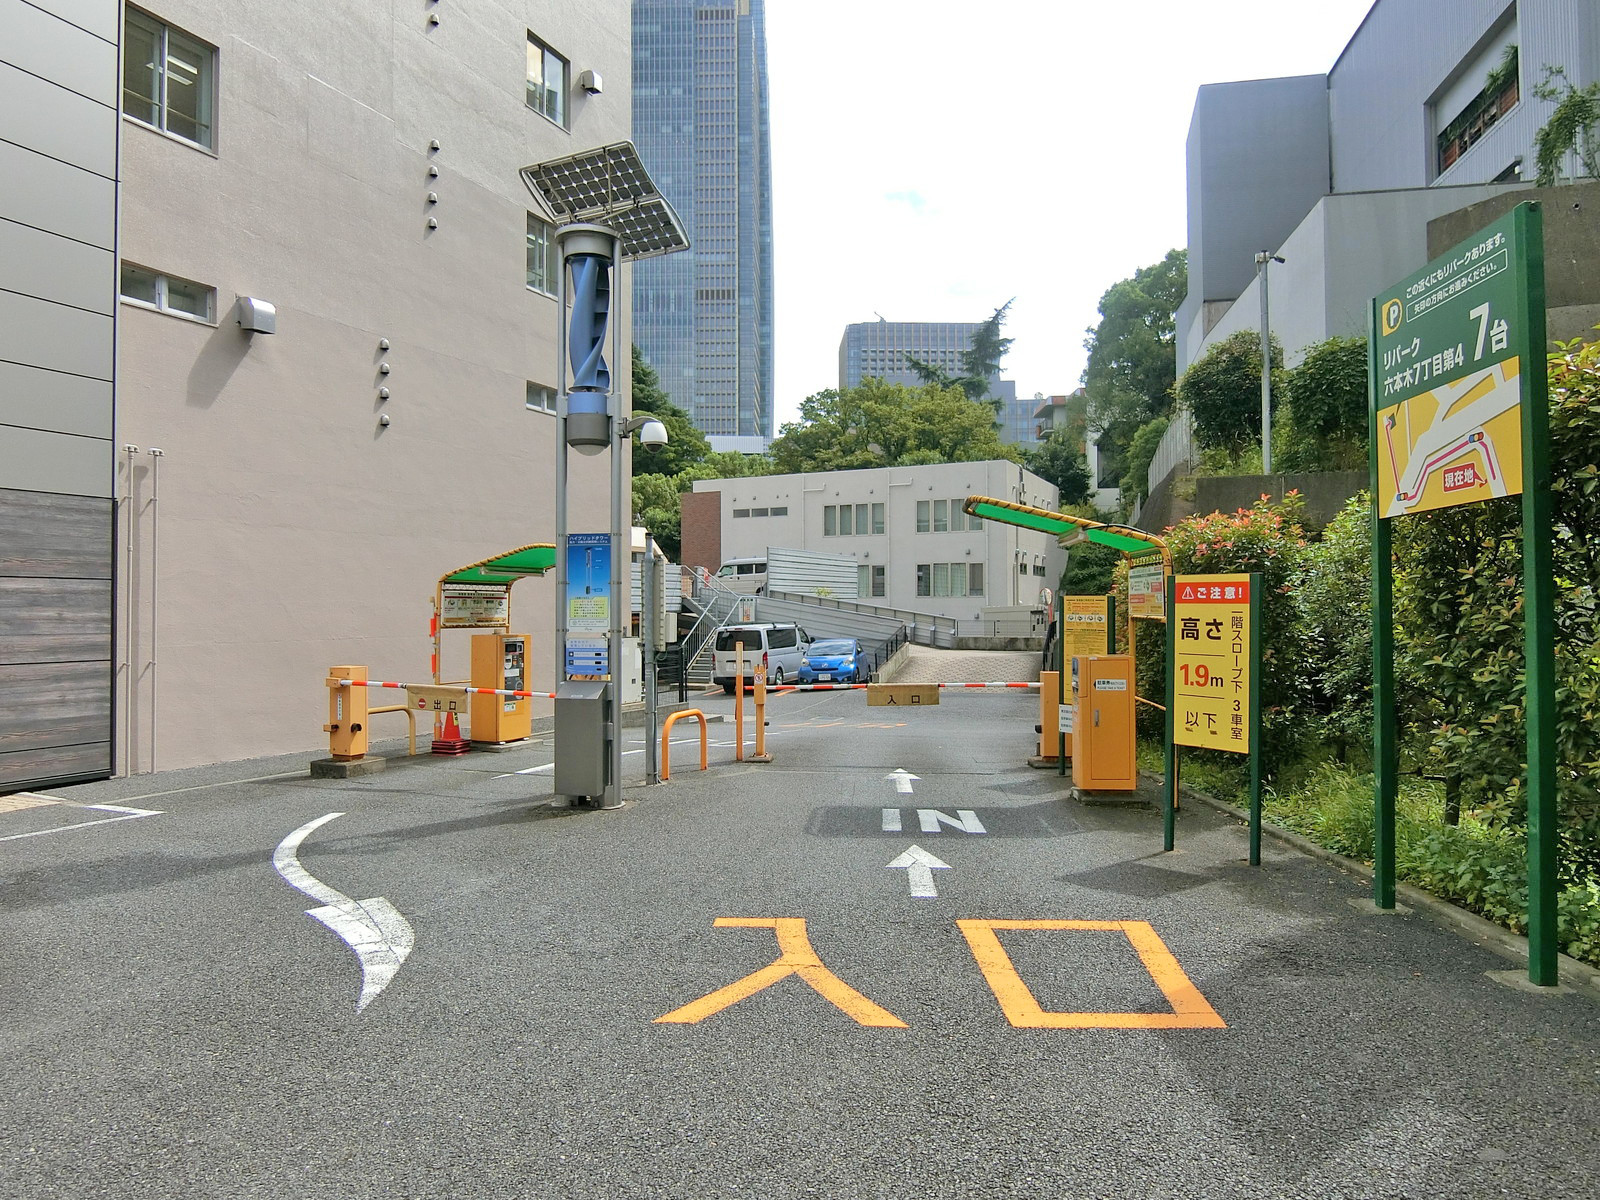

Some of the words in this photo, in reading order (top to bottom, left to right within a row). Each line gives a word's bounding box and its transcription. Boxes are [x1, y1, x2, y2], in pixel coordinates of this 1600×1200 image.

[1406, 233, 1505, 299] この近くにもリパークあります。
[1414, 262, 1497, 314] 矢印の方向にお進みください。
[1469, 302, 1508, 362] 7台
[1383, 337, 1421, 371] リパーク
[1384, 343, 1464, 397] 六本木7丁目第4
[1444, 467, 1475, 488] 現在地
[1180, 617, 1224, 641] 高さ
[1179, 663, 1224, 688] 1.9m
[433, 699, 457, 711] 出口
[887, 694, 921, 705] 入口
[1185, 710, 1217, 728] 以下
[882, 808, 988, 834] IN
[652, 916, 1228, 1030] 入口
